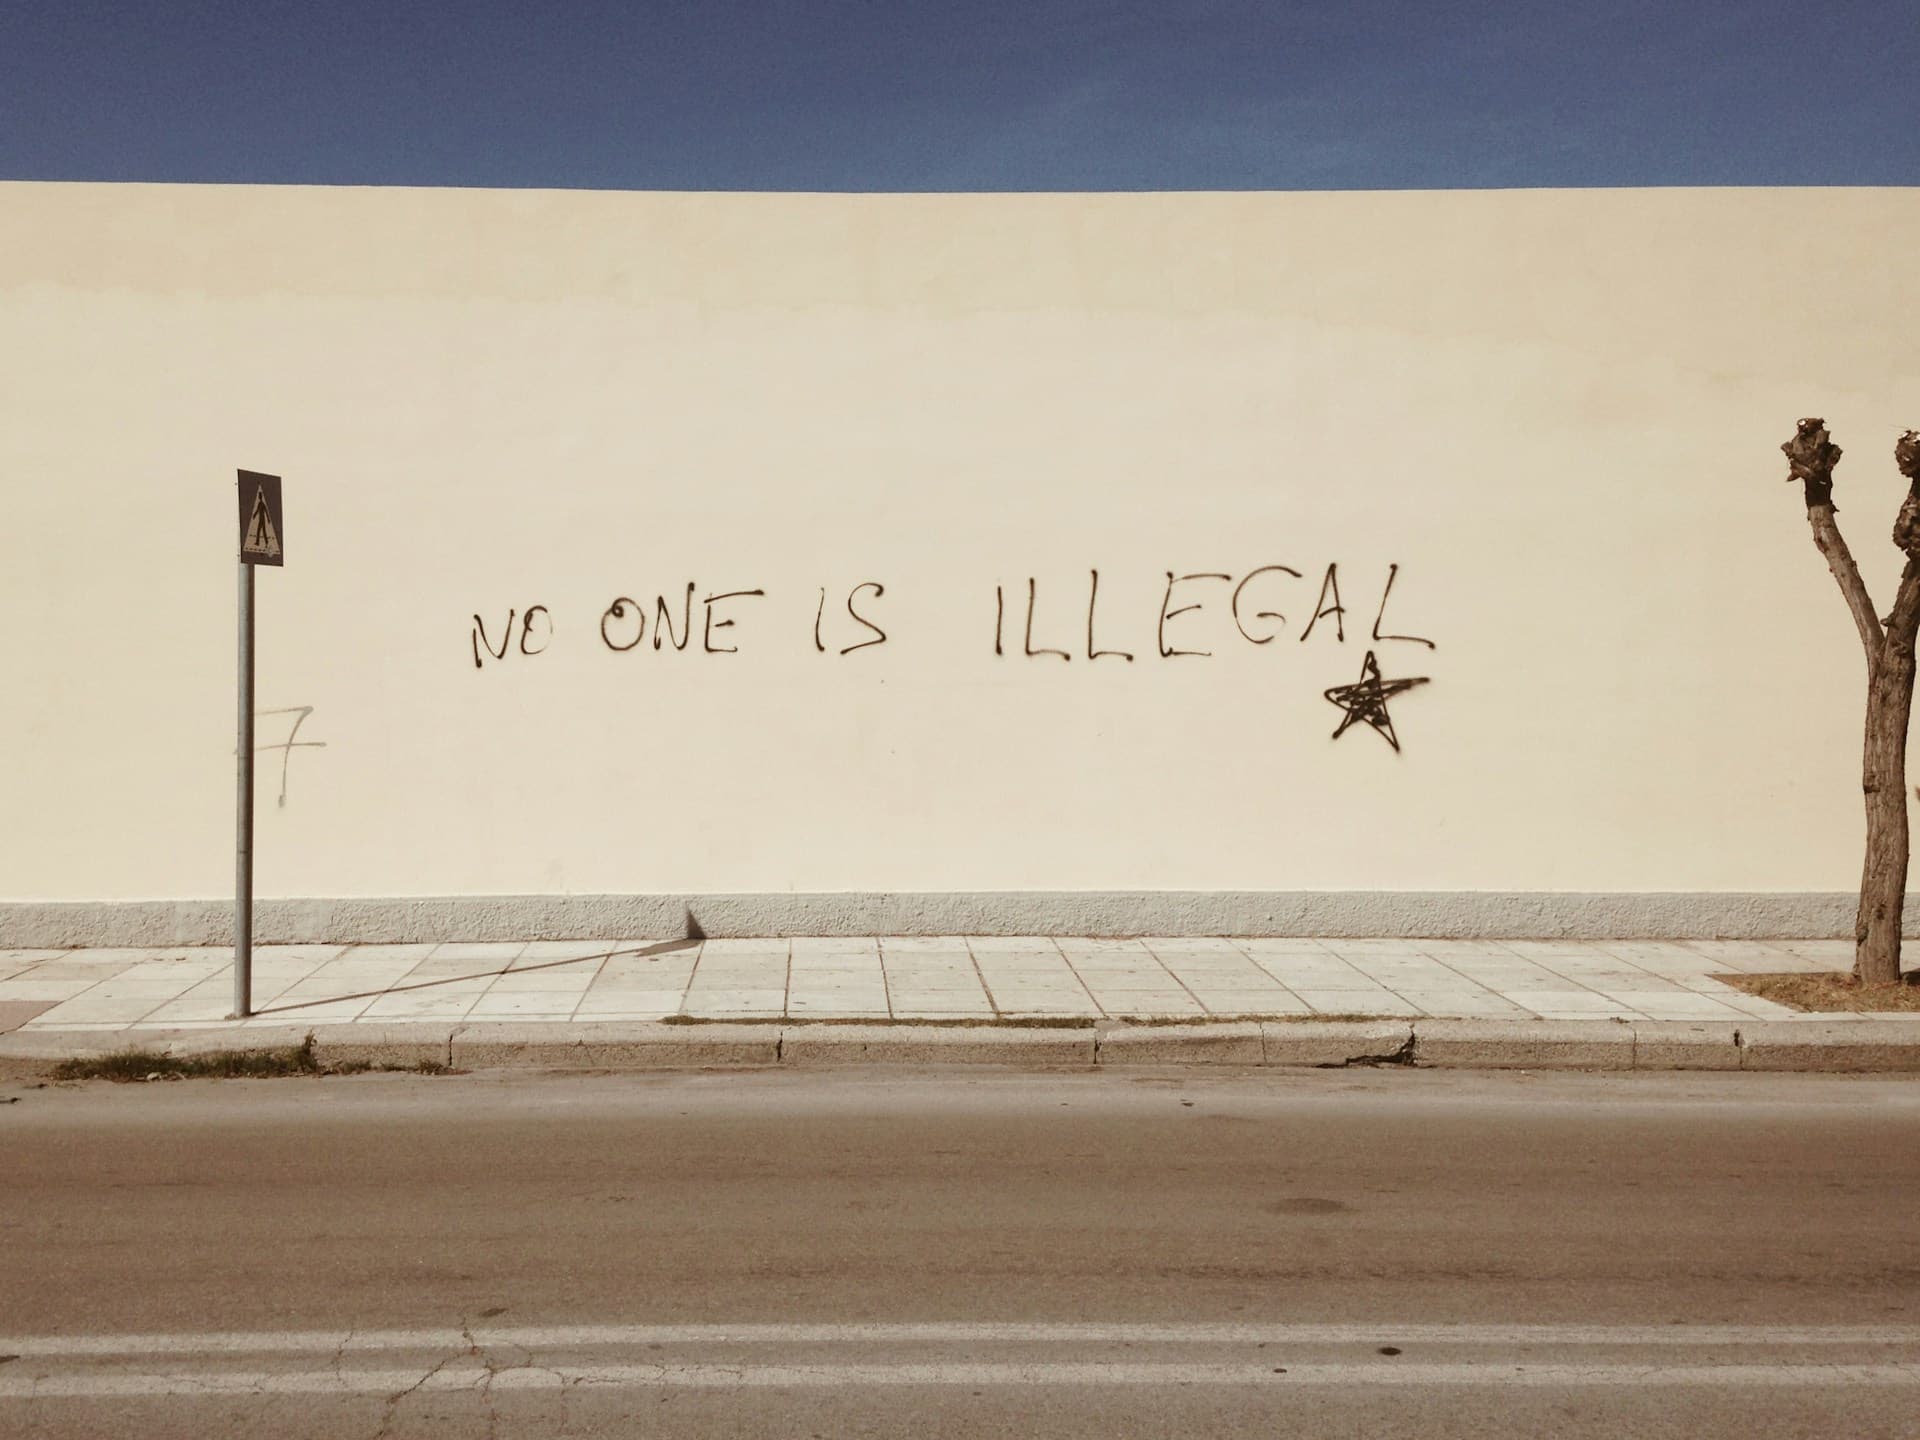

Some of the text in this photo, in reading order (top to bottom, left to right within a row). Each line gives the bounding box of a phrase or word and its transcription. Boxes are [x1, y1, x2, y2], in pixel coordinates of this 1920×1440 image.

[471, 561, 1436, 669] NO ONE IS ILLEGAL
